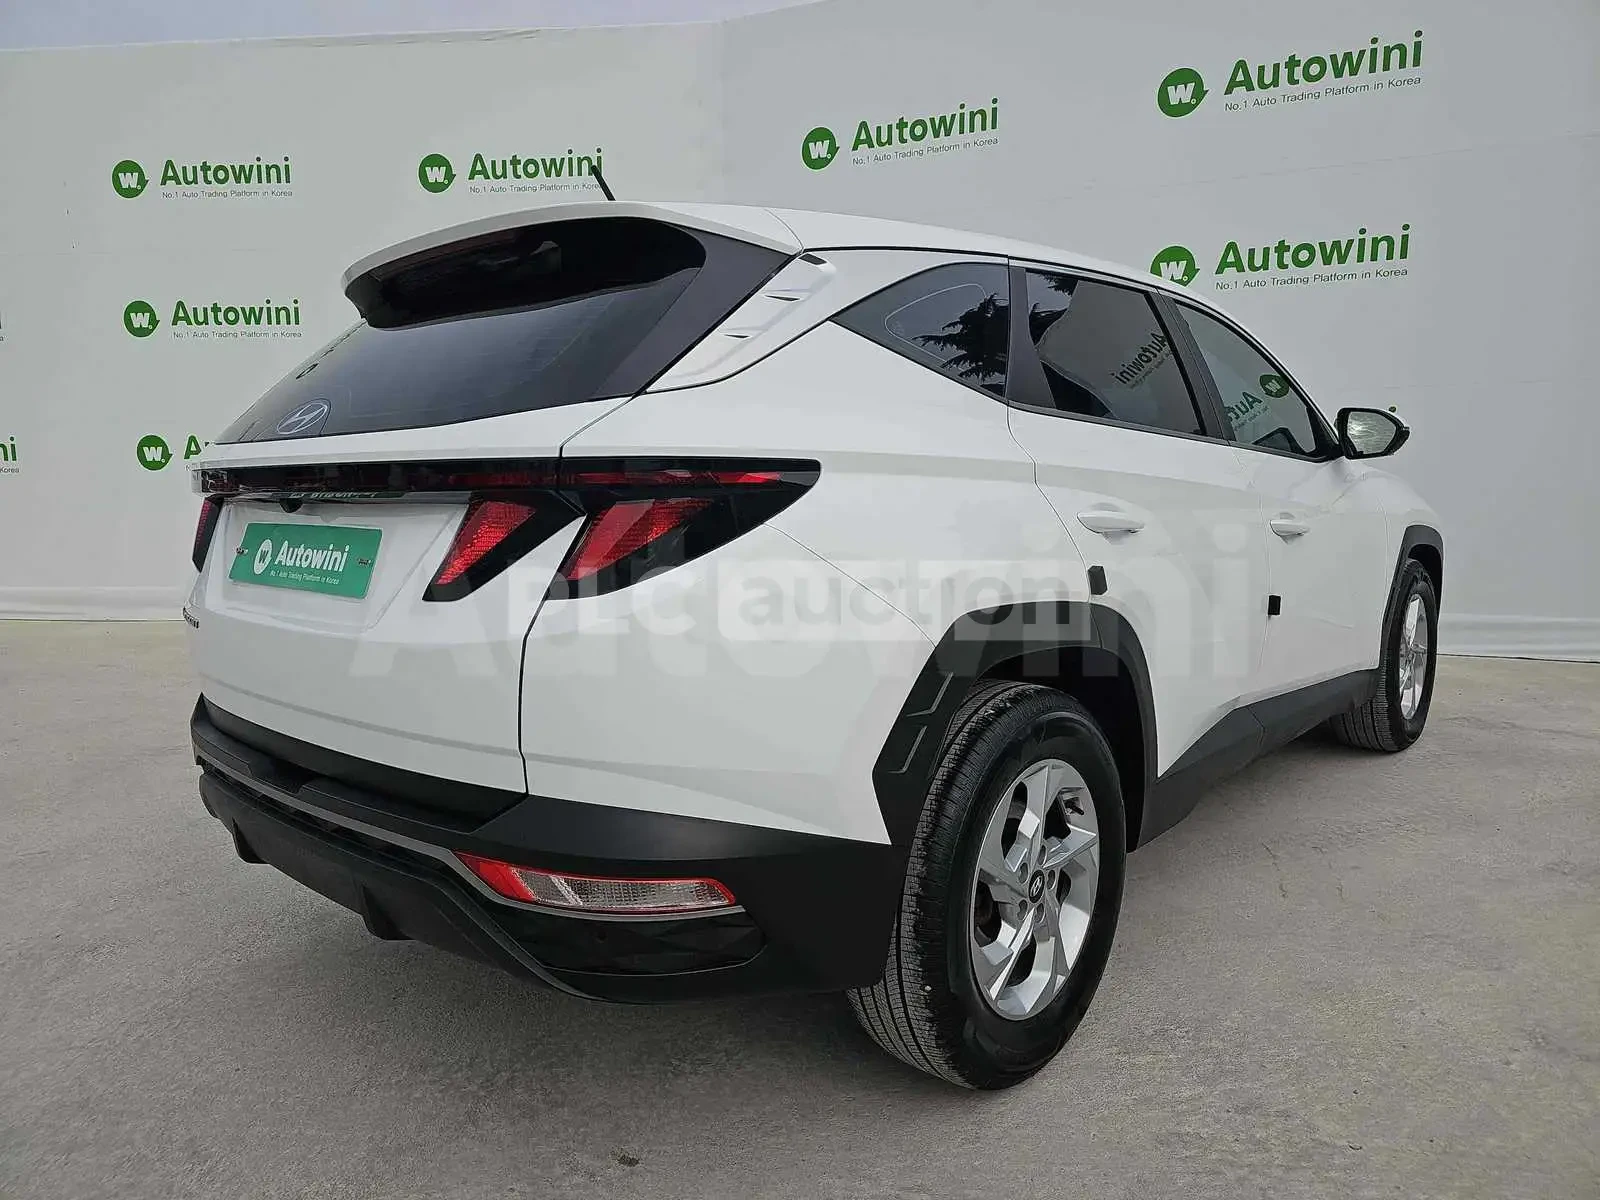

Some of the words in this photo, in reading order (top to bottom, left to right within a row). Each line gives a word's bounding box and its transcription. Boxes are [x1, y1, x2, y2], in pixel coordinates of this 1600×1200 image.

[1223, 30, 1423, 96] Autowini
[1225, 101, 1248, 112] No.1
[1252, 97, 1277, 107] Auto
[1281, 91, 1321, 103] Trading
[1324, 83, 1370, 97] Platform
[1373, 82, 1384, 91] in
[1387, 76, 1421, 88] Korea
[851, 97, 999, 152] Autowini
[468, 148, 602, 180] Autowini
[873, 153, 891, 162] Auto
[894, 149, 924, 158] Trading
[926, 143, 960, 154] Platform
[963, 141, 970, 149] in
[973, 137, 998, 147] Korea
[160, 156, 292, 186] Autowini
[200, 190, 228, 198] Trading
[230, 189, 259, 197] Platform
[262, 189, 269, 197] in
[271, 189, 293, 197] Korea
[509, 184, 537, 193] Trading
[540, 184, 571, 192] Platform
[1214, 223, 1411, 275] Autowini
[1215, 280, 1238, 291] No.1
[1243, 278, 1267, 288] Auto
[1271, 276, 1310, 287] Trading
[1313, 272, 1357, 283] Platform
[1361, 271, 1371, 279] in
[1375, 267, 1408, 278] Korea
[171, 299, 300, 326] Autowini
[211, 330, 238, 339] Trading
[240, 330, 270, 338] Platform
[272, 330, 279, 338] in
[280, 330, 302, 338] Korea
[275, 540, 350, 572] Autowini
